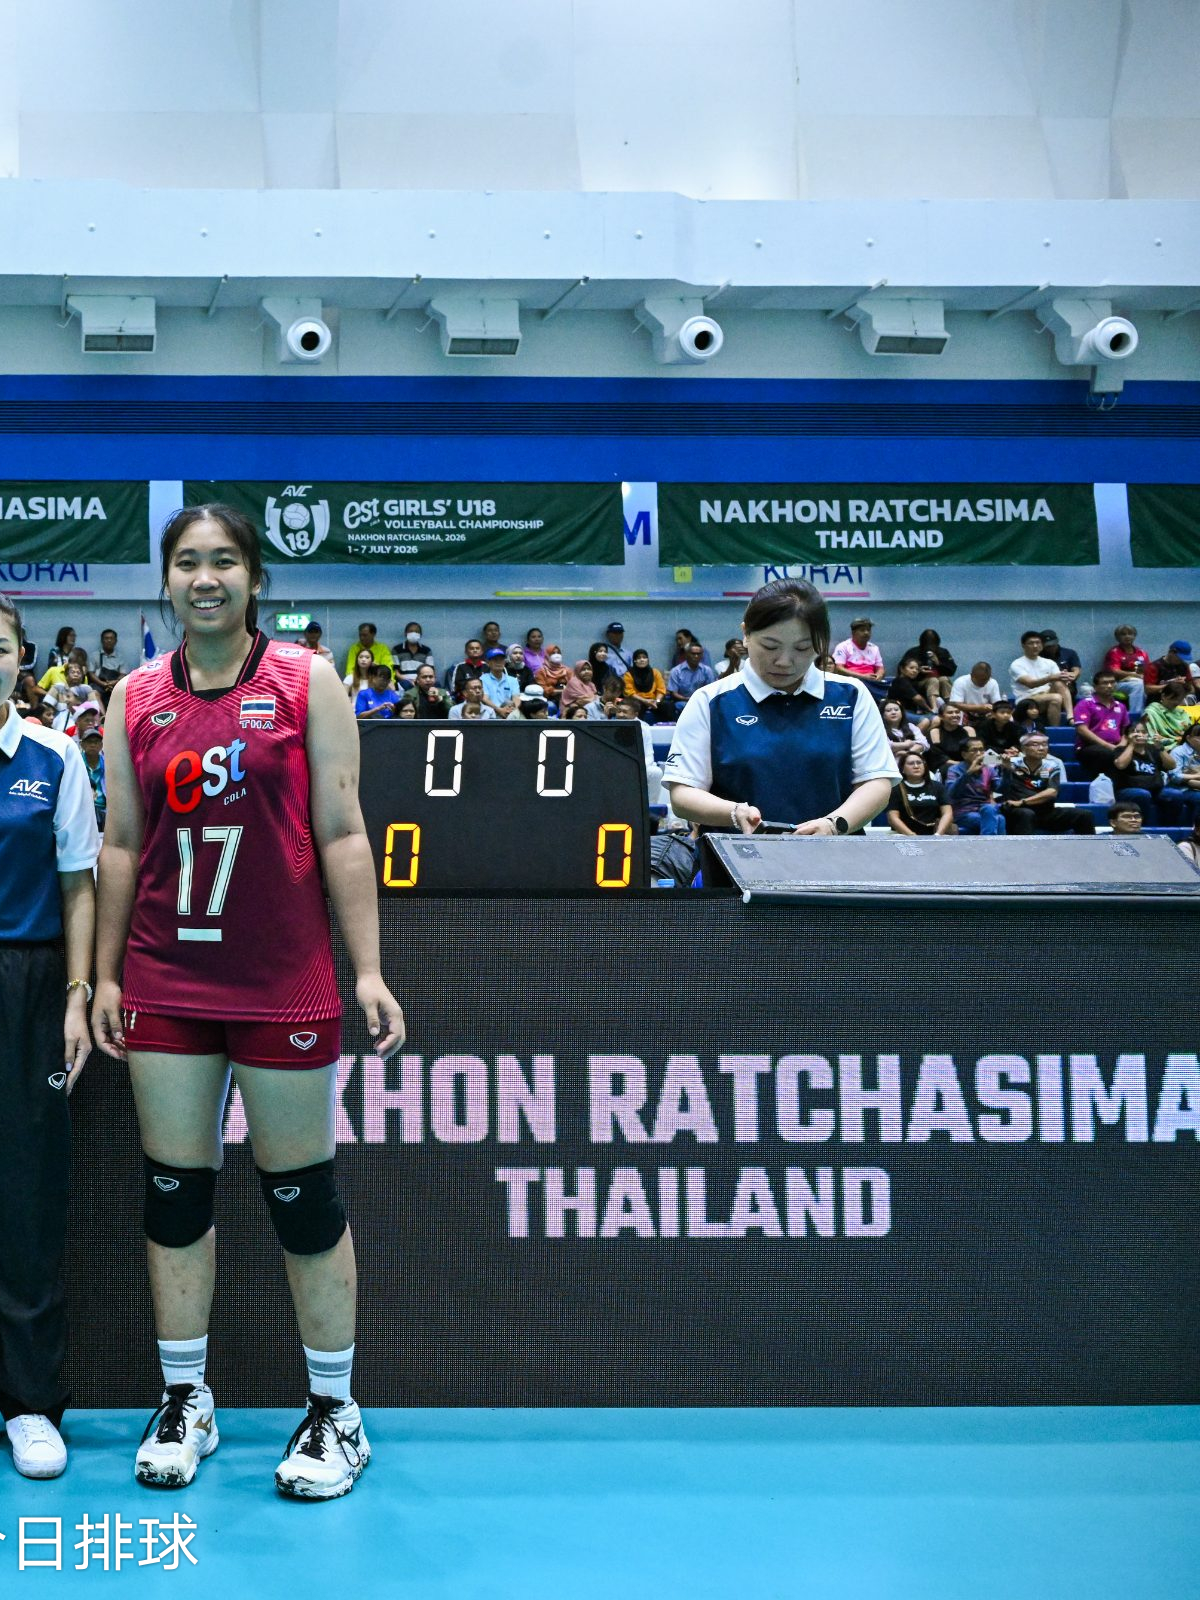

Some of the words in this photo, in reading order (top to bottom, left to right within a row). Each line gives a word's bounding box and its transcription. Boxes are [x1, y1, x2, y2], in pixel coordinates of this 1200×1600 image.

[281, 485, 313, 497] AVC
[343, 498, 380, 529] est
[384, 499, 452, 517] GIRLS'
[457, 499, 497, 517] U18
[700, 499, 841, 523] NAKHON
[848, 498, 1055, 523] RATCHASIMA
[384, 519, 457, 530] VOLLEYBALL
[458, 519, 544, 530] CHAMPIONSHIP
[286, 530, 311, 551] 18
[348, 533, 385, 542] NAKHON
[387, 533, 444, 543] RATCHASIMA,
[445, 533, 466, 542] 2026
[815, 528, 944, 549] THAILAND
[348, 545, 352, 554] 1
[361, 545, 367, 554] 7
[368, 545, 392, 554] JULY
[393, 545, 418, 554] 2026
[820, 705, 851, 716] AVC
[239, 719, 274, 730] THA
[424, 729, 464, 797] 0
[536, 729, 576, 797] 0
[10, 779, 51, 794] AVC
[165, 738, 247, 814] est
[223, 788, 247, 805] COLA
[383, 823, 422, 888] 0
[596, 823, 632, 888] 0
[176, 825, 244, 915] 17
[588, 1053, 1200, 1144] RATCHASIMA
[495, 1166, 892, 1239] THAILAND
